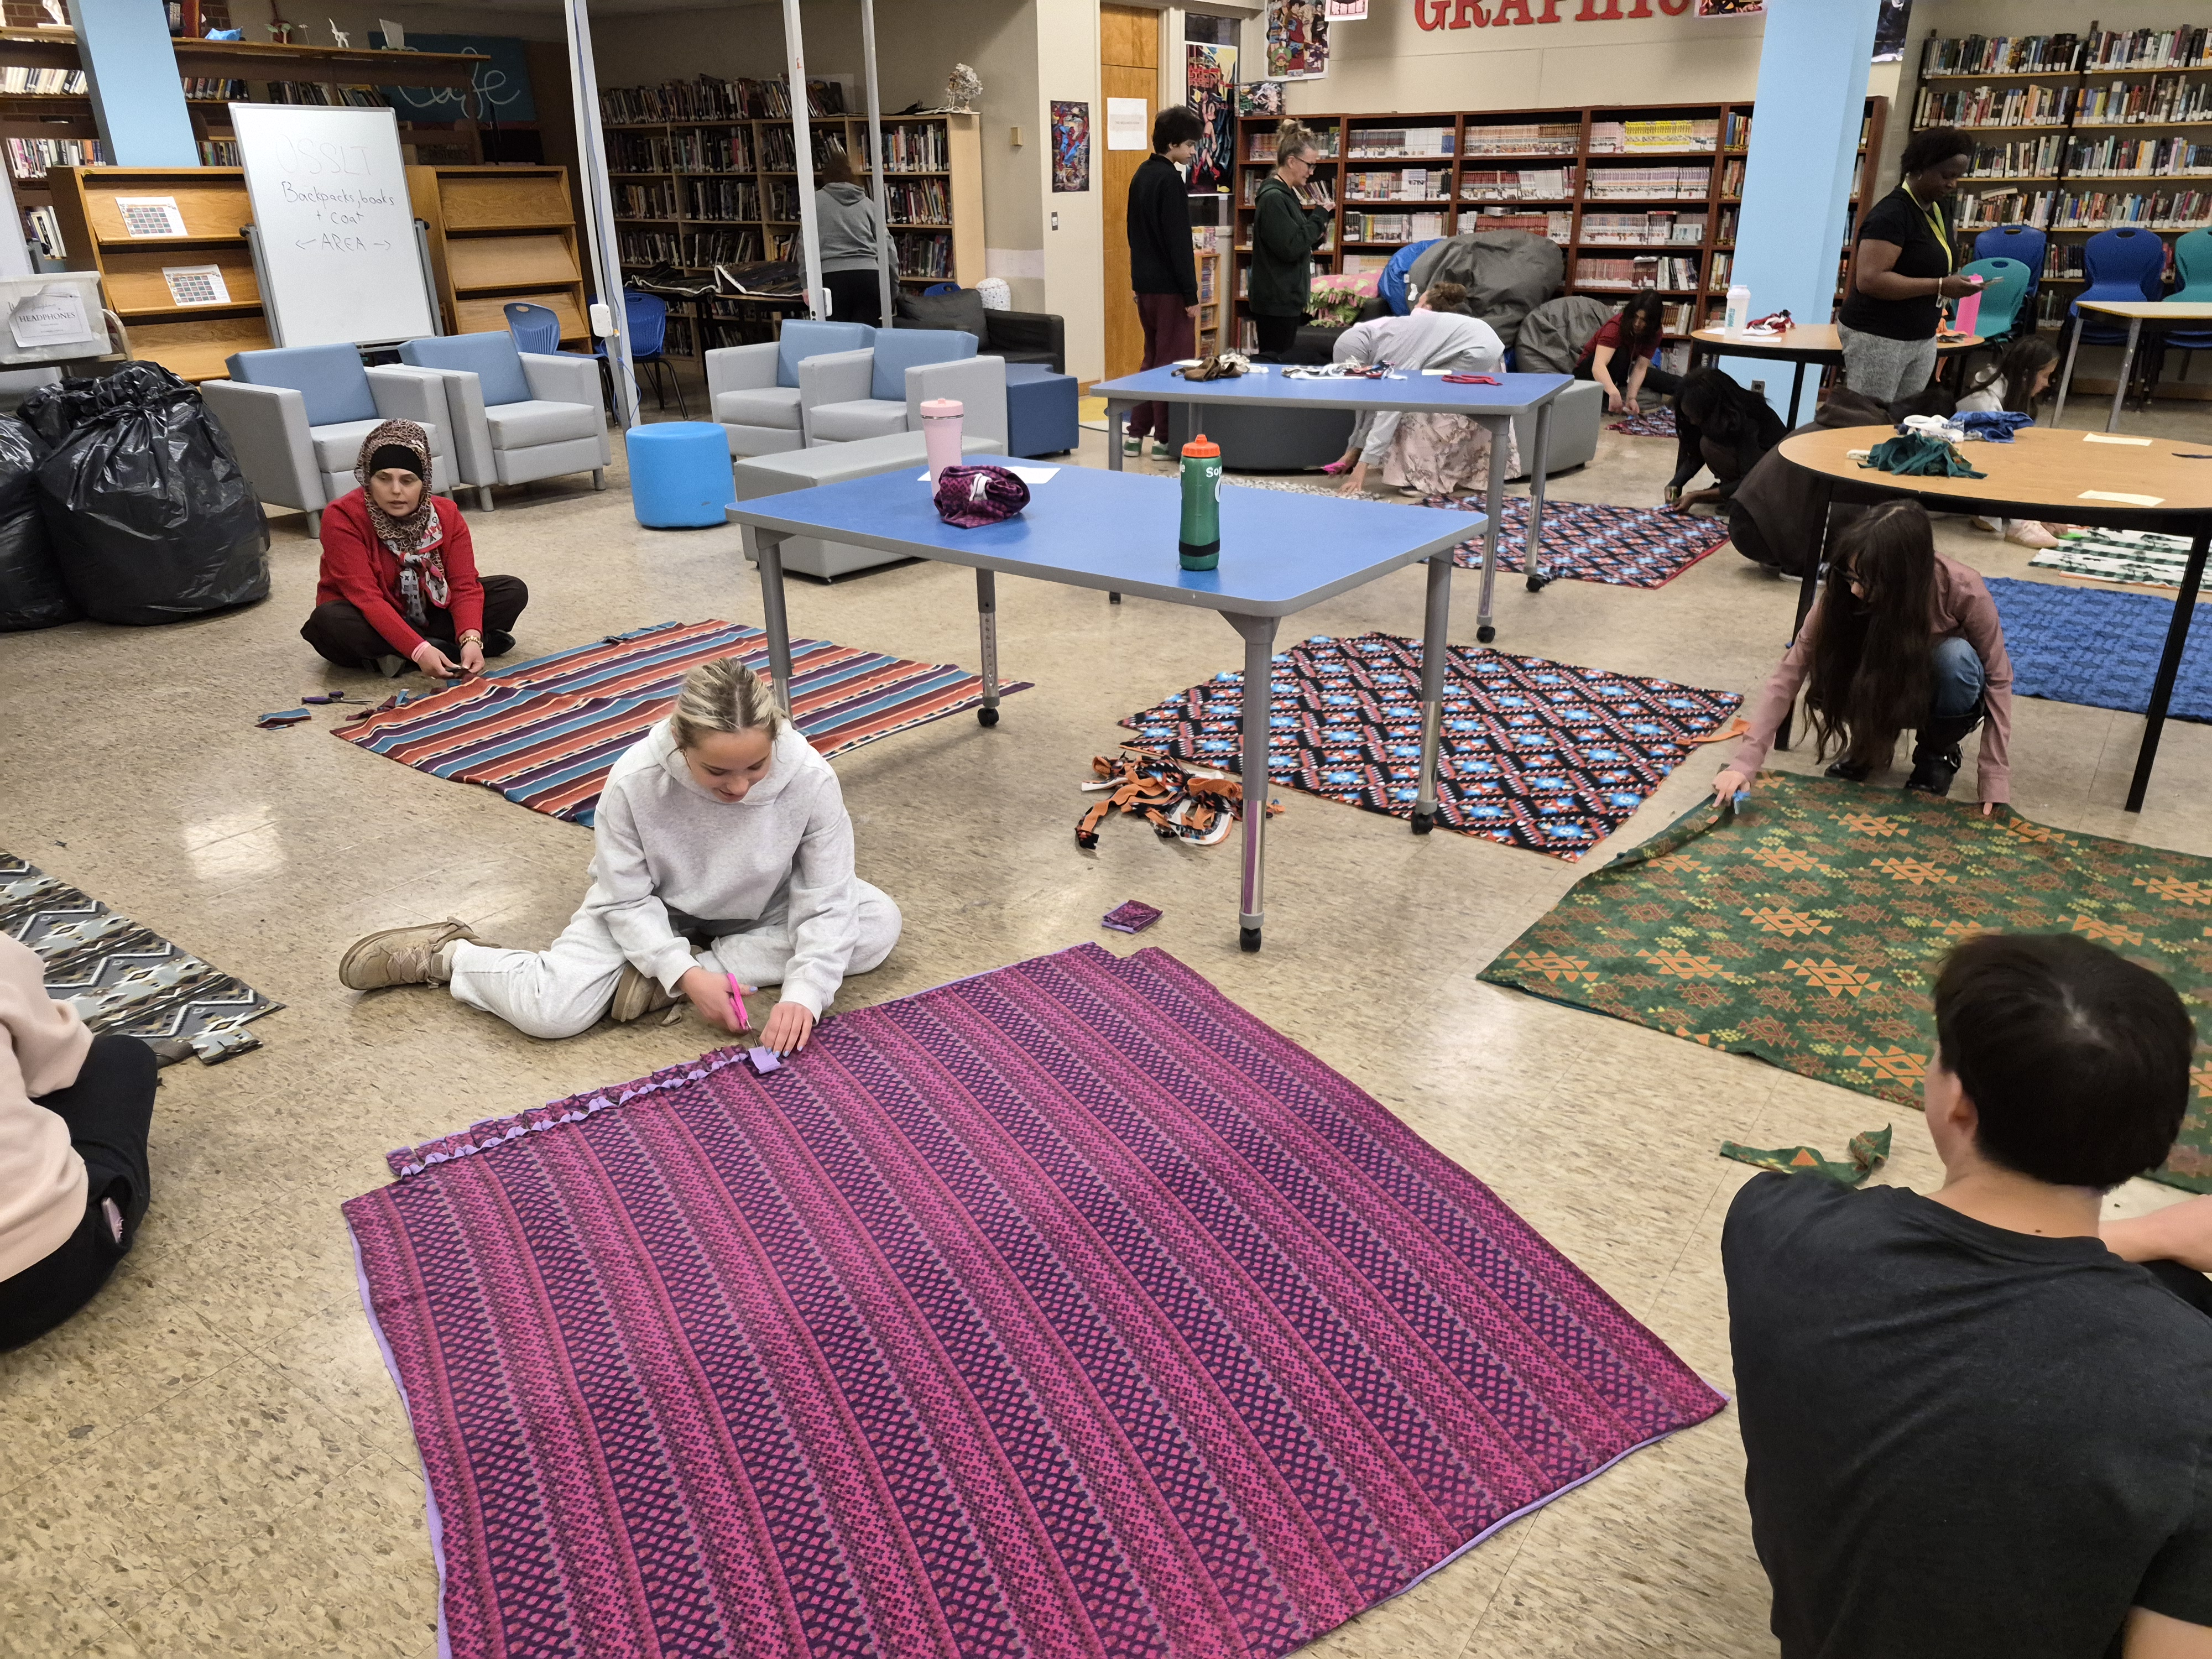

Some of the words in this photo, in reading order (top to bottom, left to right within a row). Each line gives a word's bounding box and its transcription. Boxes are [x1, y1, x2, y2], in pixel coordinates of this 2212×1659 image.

[276, 133, 371, 176] OSSLT
[321, 232, 367, 252] AREA
[19, 312, 76, 322] HEADPHONES
